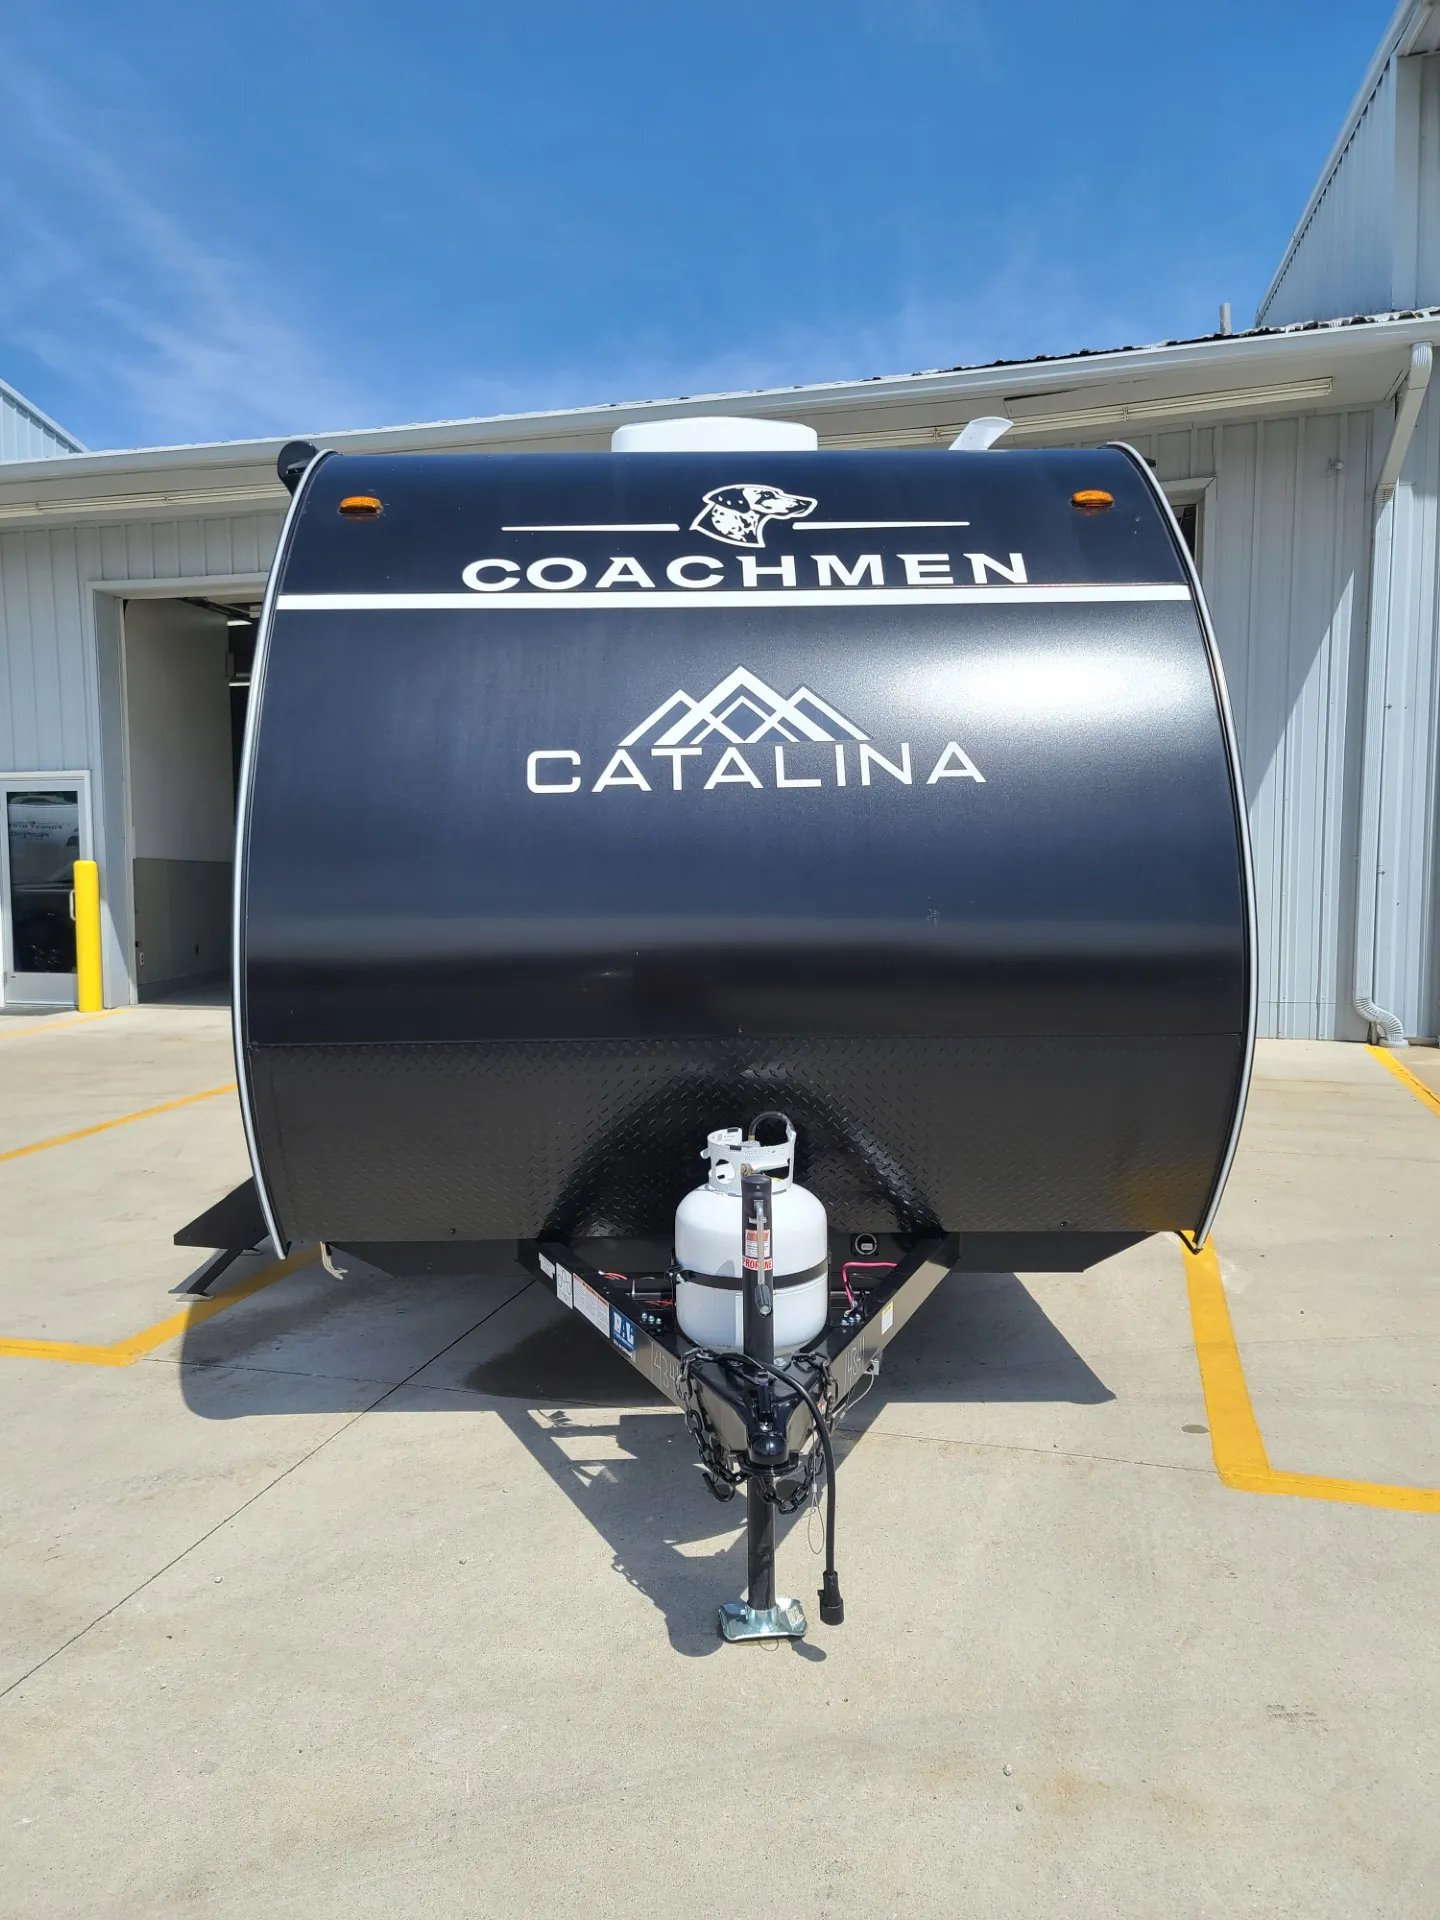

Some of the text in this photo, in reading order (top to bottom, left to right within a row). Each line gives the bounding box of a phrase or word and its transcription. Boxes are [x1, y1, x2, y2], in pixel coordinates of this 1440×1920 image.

[461, 552, 1028, 592] COACHMEN
[525, 741, 987, 794] CATALINA
[743, 1256, 772, 1270] PROPNE
